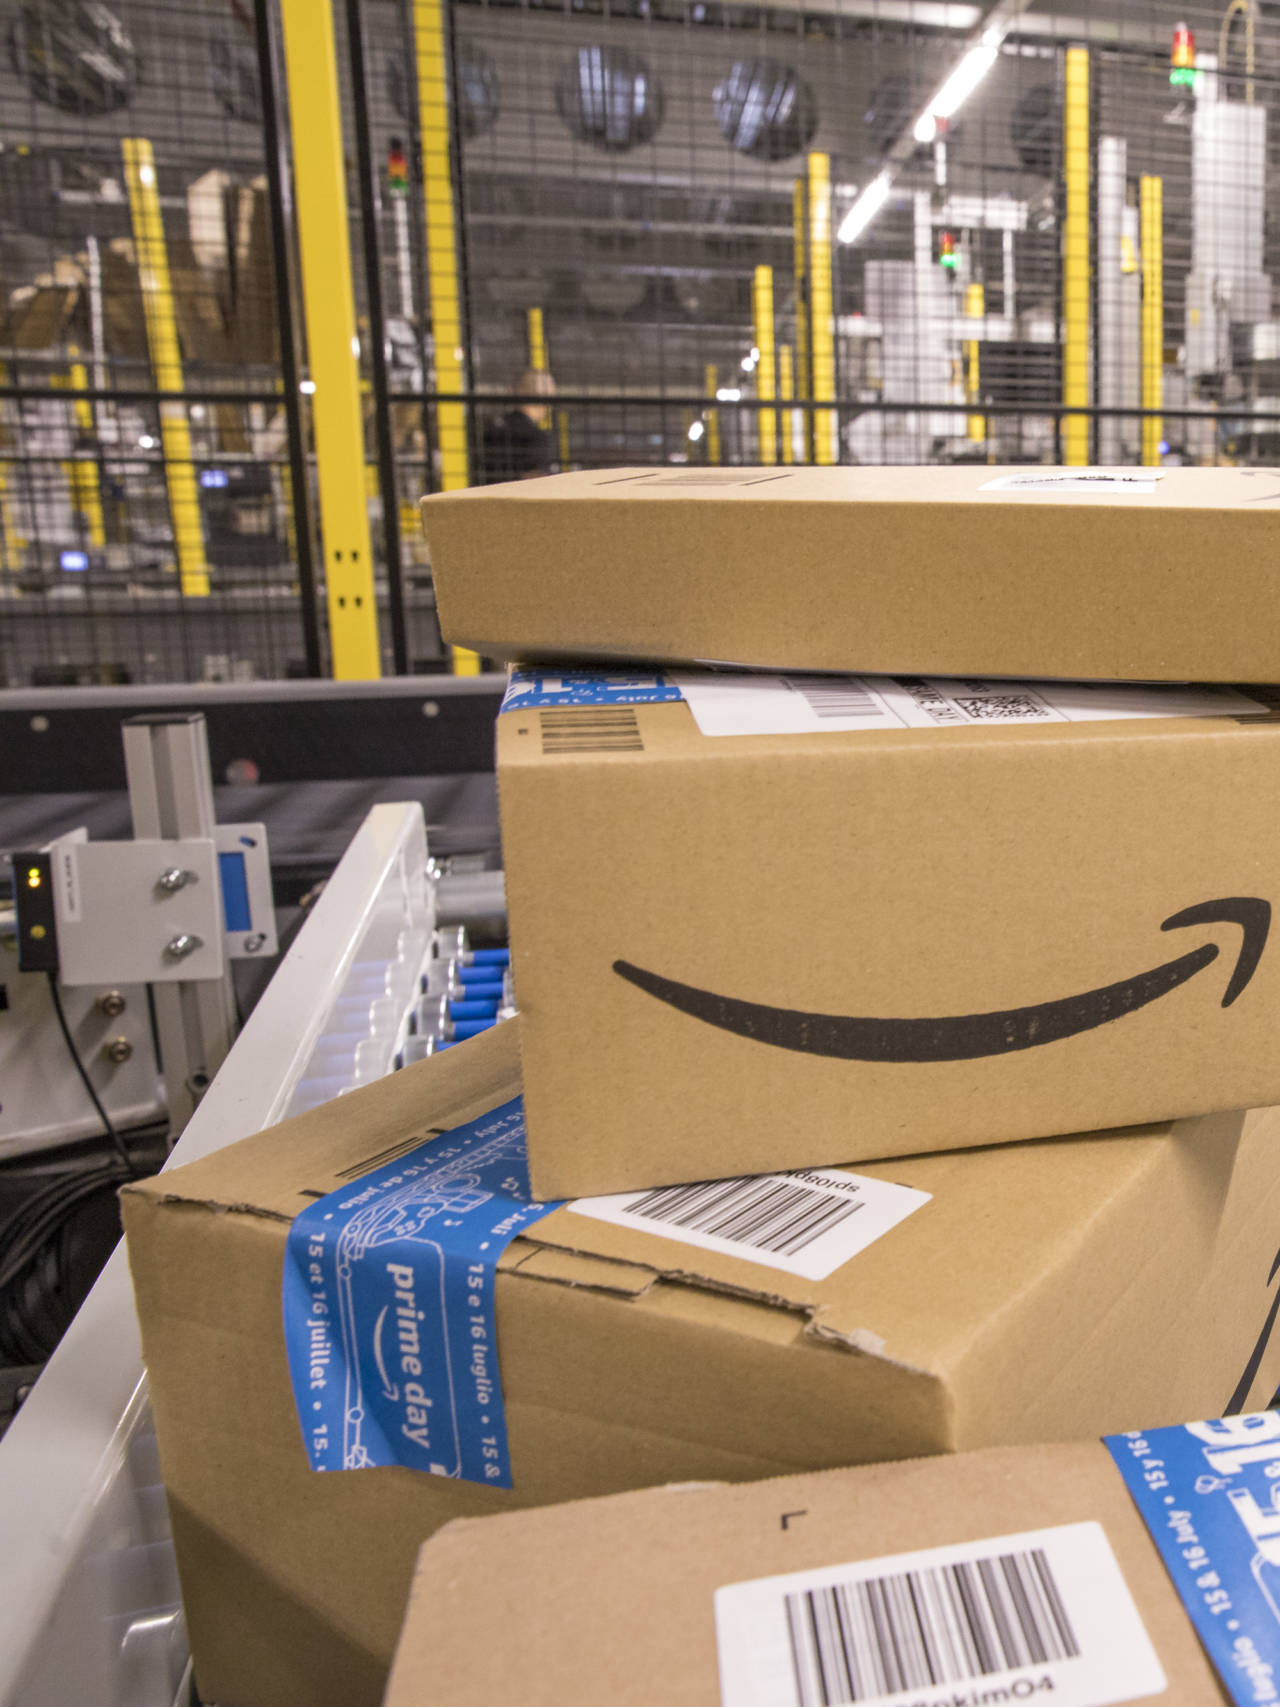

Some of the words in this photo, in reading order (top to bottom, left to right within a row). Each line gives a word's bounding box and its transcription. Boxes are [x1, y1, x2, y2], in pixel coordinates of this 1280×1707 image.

[475, 1121, 509, 1138] July
[439, 1147, 463, 1159] 15
[380, 1176, 404, 1188] de
[403, 1165, 428, 1177] 16
[338, 1186, 385, 1210] julio
[491, 1211, 527, 1236] Juli
[308, 1232, 326, 1258] 15
[308, 1262, 324, 1285] et
[467, 1263, 485, 1290] 15
[312, 1291, 329, 1315] 16
[468, 1293, 482, 1308] e
[386, 1262, 425, 1377] prime
[470, 1314, 487, 1340] 16
[307, 1318, 332, 1390] juillet
[470, 1344, 493, 1405] luglio
[402, 1381, 433, 1449] day
[312, 1423, 329, 1459] 15.
[481, 1435, 499, 1459] 15
[1128, 1439, 1151, 1457] 16
[1142, 1459, 1165, 1470] y
[1144, 1470, 1169, 1491] 15
[1168, 1510, 1199, 1543] July
[1182, 1546, 1210, 1570] 16
[1196, 1570, 1221, 1589] &
[1204, 1589, 1232, 1615] 15
